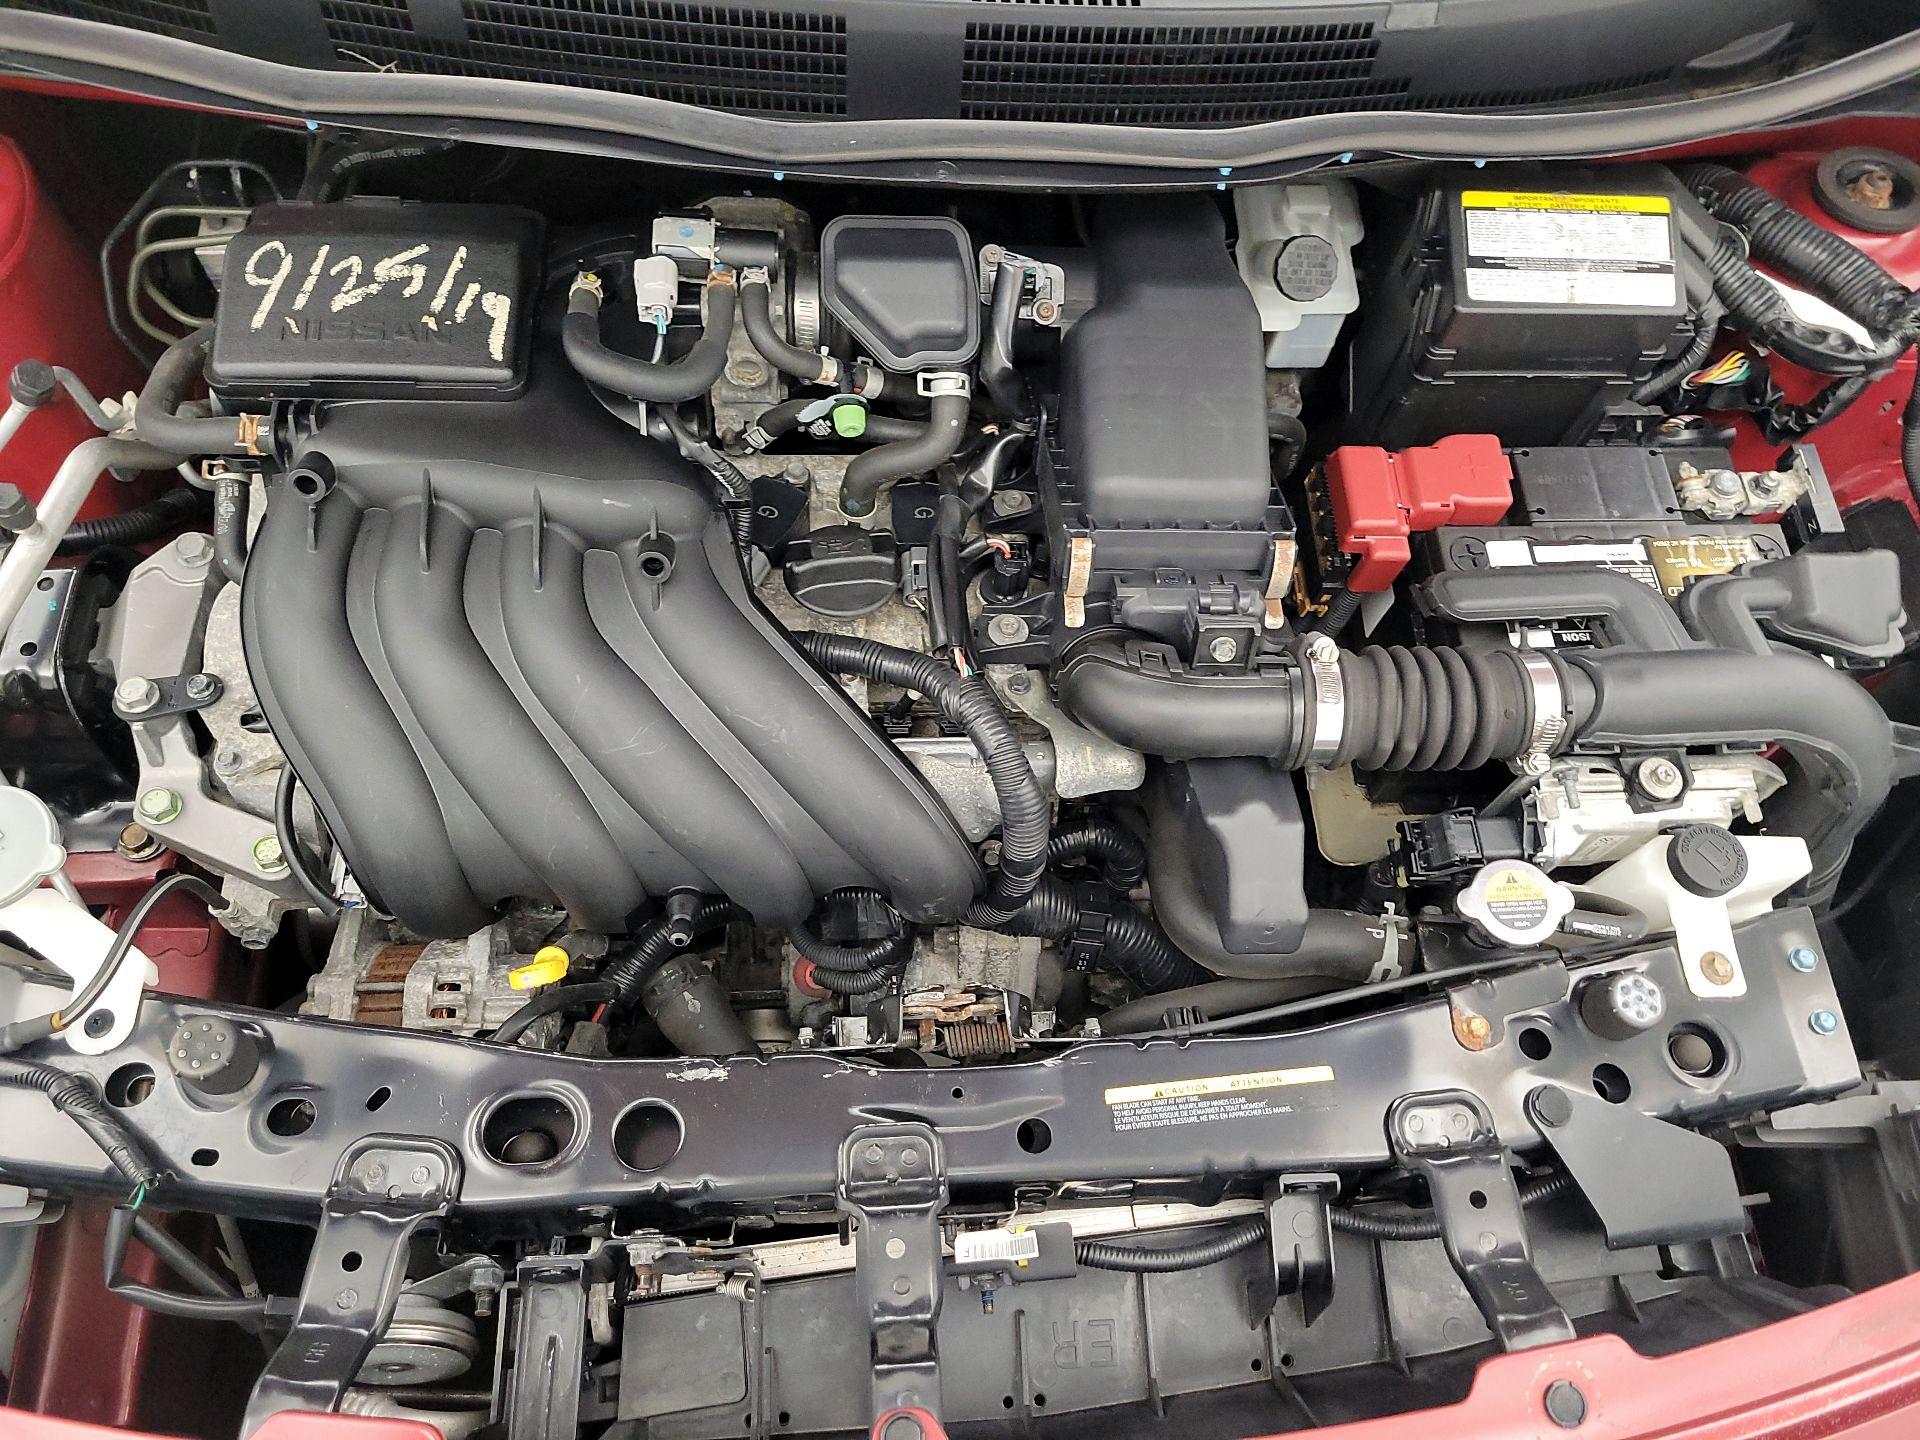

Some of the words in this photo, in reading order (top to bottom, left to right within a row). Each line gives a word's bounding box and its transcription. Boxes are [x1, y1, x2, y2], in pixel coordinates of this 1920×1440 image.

[281, 319, 452, 342] NISSAN
[1562, 632, 1591, 642] ISON
[1164, 1084, 1209, 1095] CAUTION
[1230, 1076, 1282, 1088] ATTENTION
[1113, 1110, 1121, 1118] TO
[1122, 1108, 1135, 1117] HELP
[1135, 1107, 1152, 1116] AVOID
[1152, 1104, 1179, 1114] PERSONAL
[1198, 1100, 1211, 1108] KEEP
[1211, 1098, 1229, 1106] HANDS
[1122, 1113, 1159, 1123] VENTILATEUR
[1159, 1111, 1180, 1120] RISQUE
[1225, 1103, 1240, 1112] TOUT
[1123, 1102, 1140, 1110] BLADE
[1140, 1100, 1152, 1108] CAN
[1152, 1098, 1168, 1107] START
[1175, 1096, 1187, 1104] ANY
[1115, 1123, 1132, 1131] POUR
[1152, 1119, 1171, 1127] TOUTE
[1209, 1112, 1220, 1121] PAS
[1228, 1109, 1262, 1119] APPROCHER
[1262, 1107, 1272, 1115] LES
